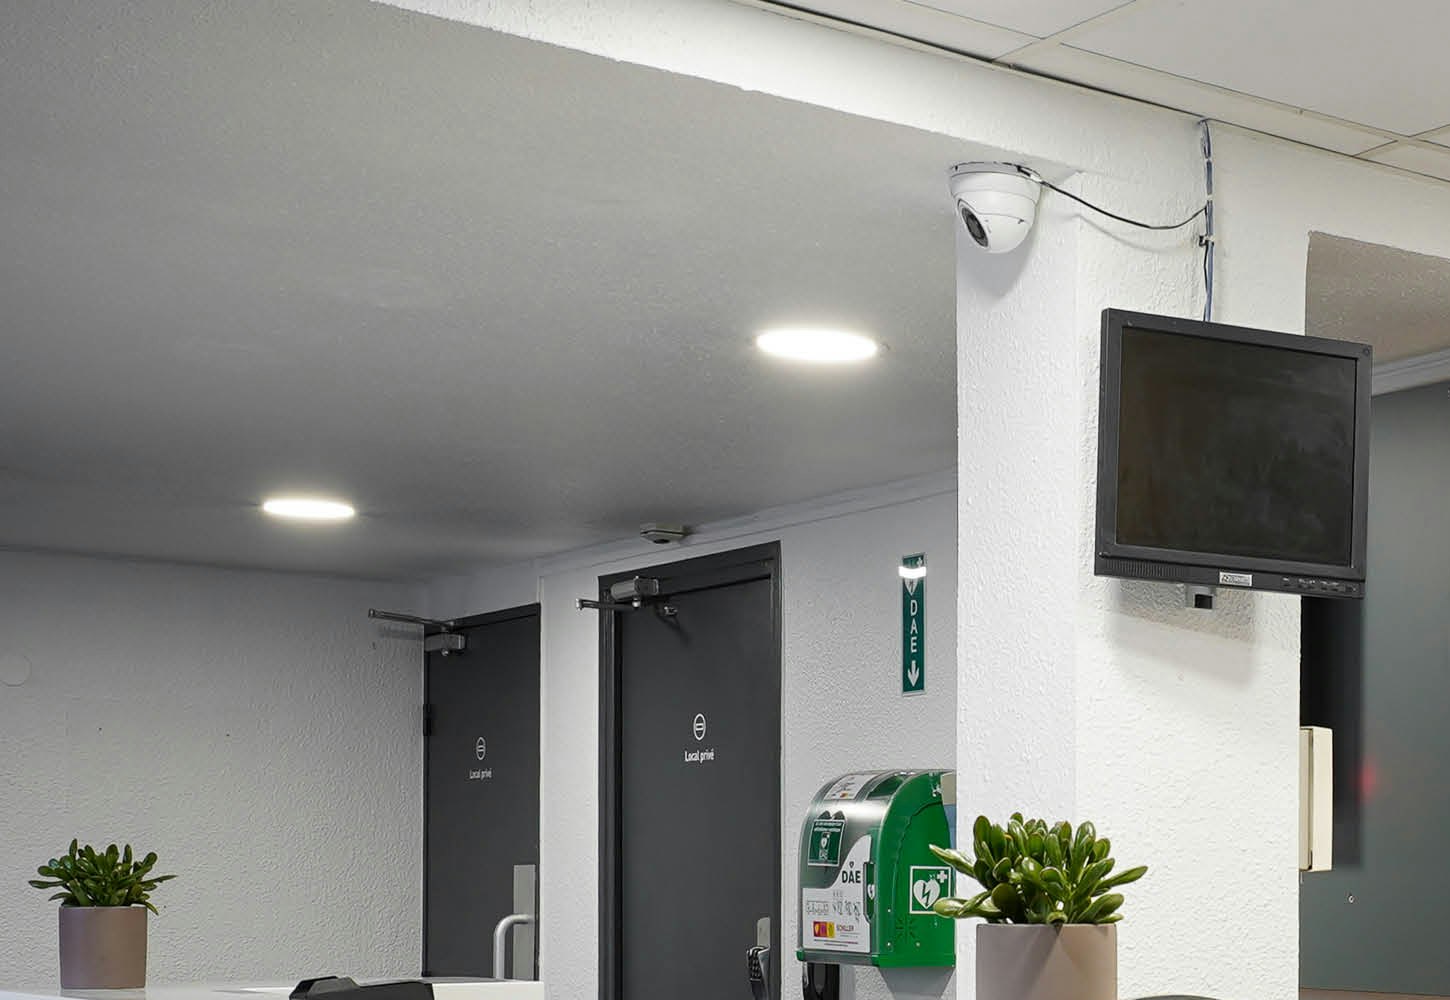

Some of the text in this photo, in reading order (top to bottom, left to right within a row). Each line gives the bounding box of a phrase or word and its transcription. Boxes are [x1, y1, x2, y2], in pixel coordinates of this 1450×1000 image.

[910, 599, 918, 653] DAE
[684, 748, 714, 764] Local privé
[841, 870, 862, 884] DAE
